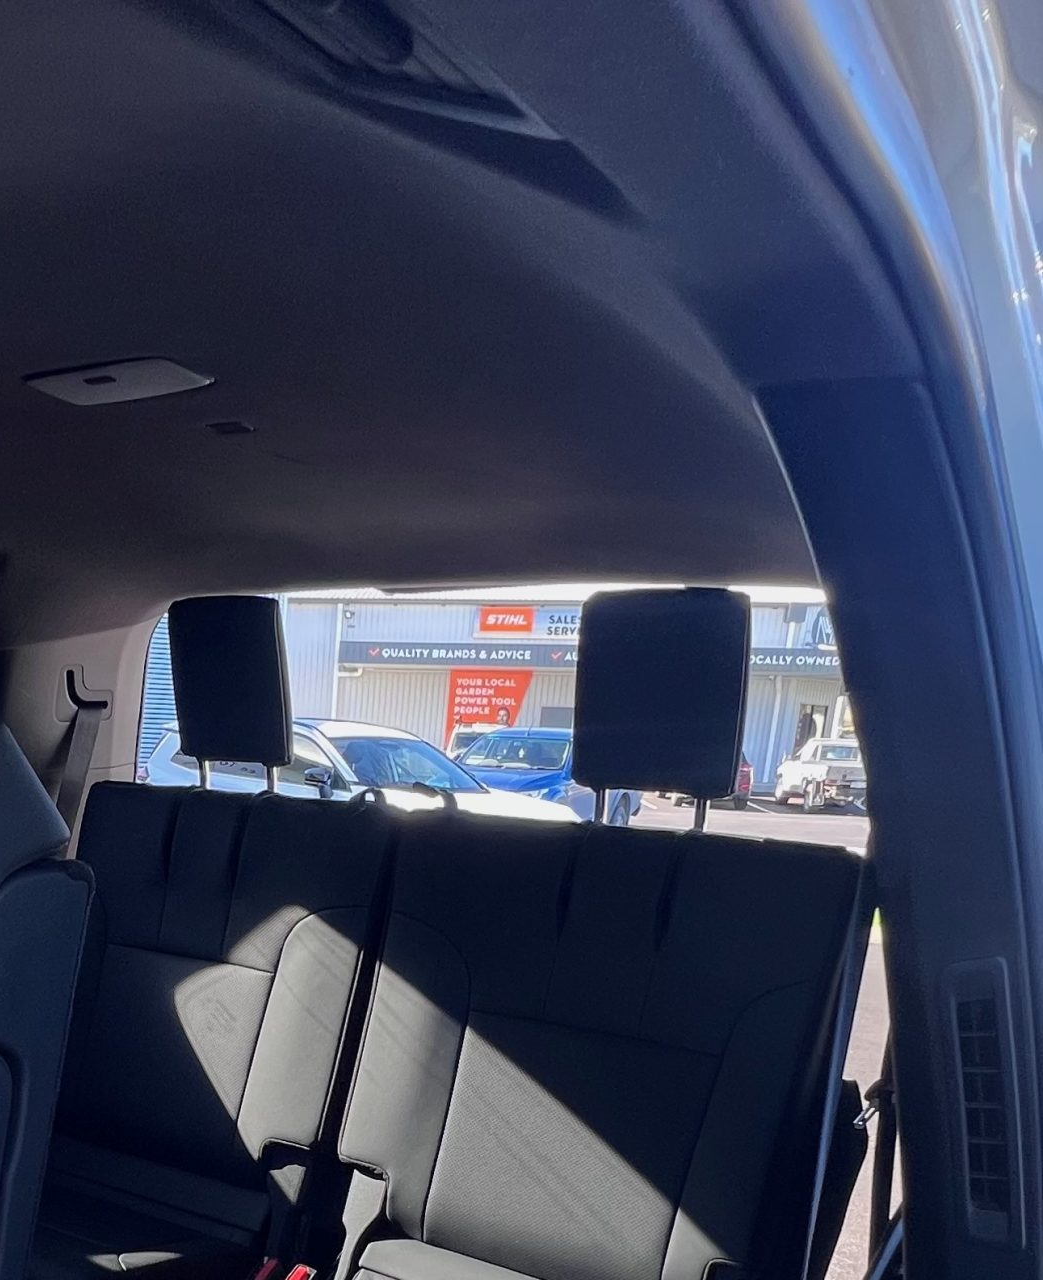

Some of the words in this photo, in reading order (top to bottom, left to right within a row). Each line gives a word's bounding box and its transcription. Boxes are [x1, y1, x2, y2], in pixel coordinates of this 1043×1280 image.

[486, 613, 527, 625] STIHL
[381, 648, 429, 659] QUALITY
[432, 649, 476, 659] BRANDS
[478, 650, 487, 660] &
[490, 650, 532, 660] ADVICE
[750, 655, 792, 665] OCALLY
[796, 655, 840, 666] OWNED
[457, 678, 483, 686] YOUR
[485, 678, 516, 687] LOCAL
[456, 688, 494, 696] GARDEN
[454, 696, 488, 705] POWER
[491, 697, 516, 706] TOOL
[454, 706, 490, 715] PEOPLE
